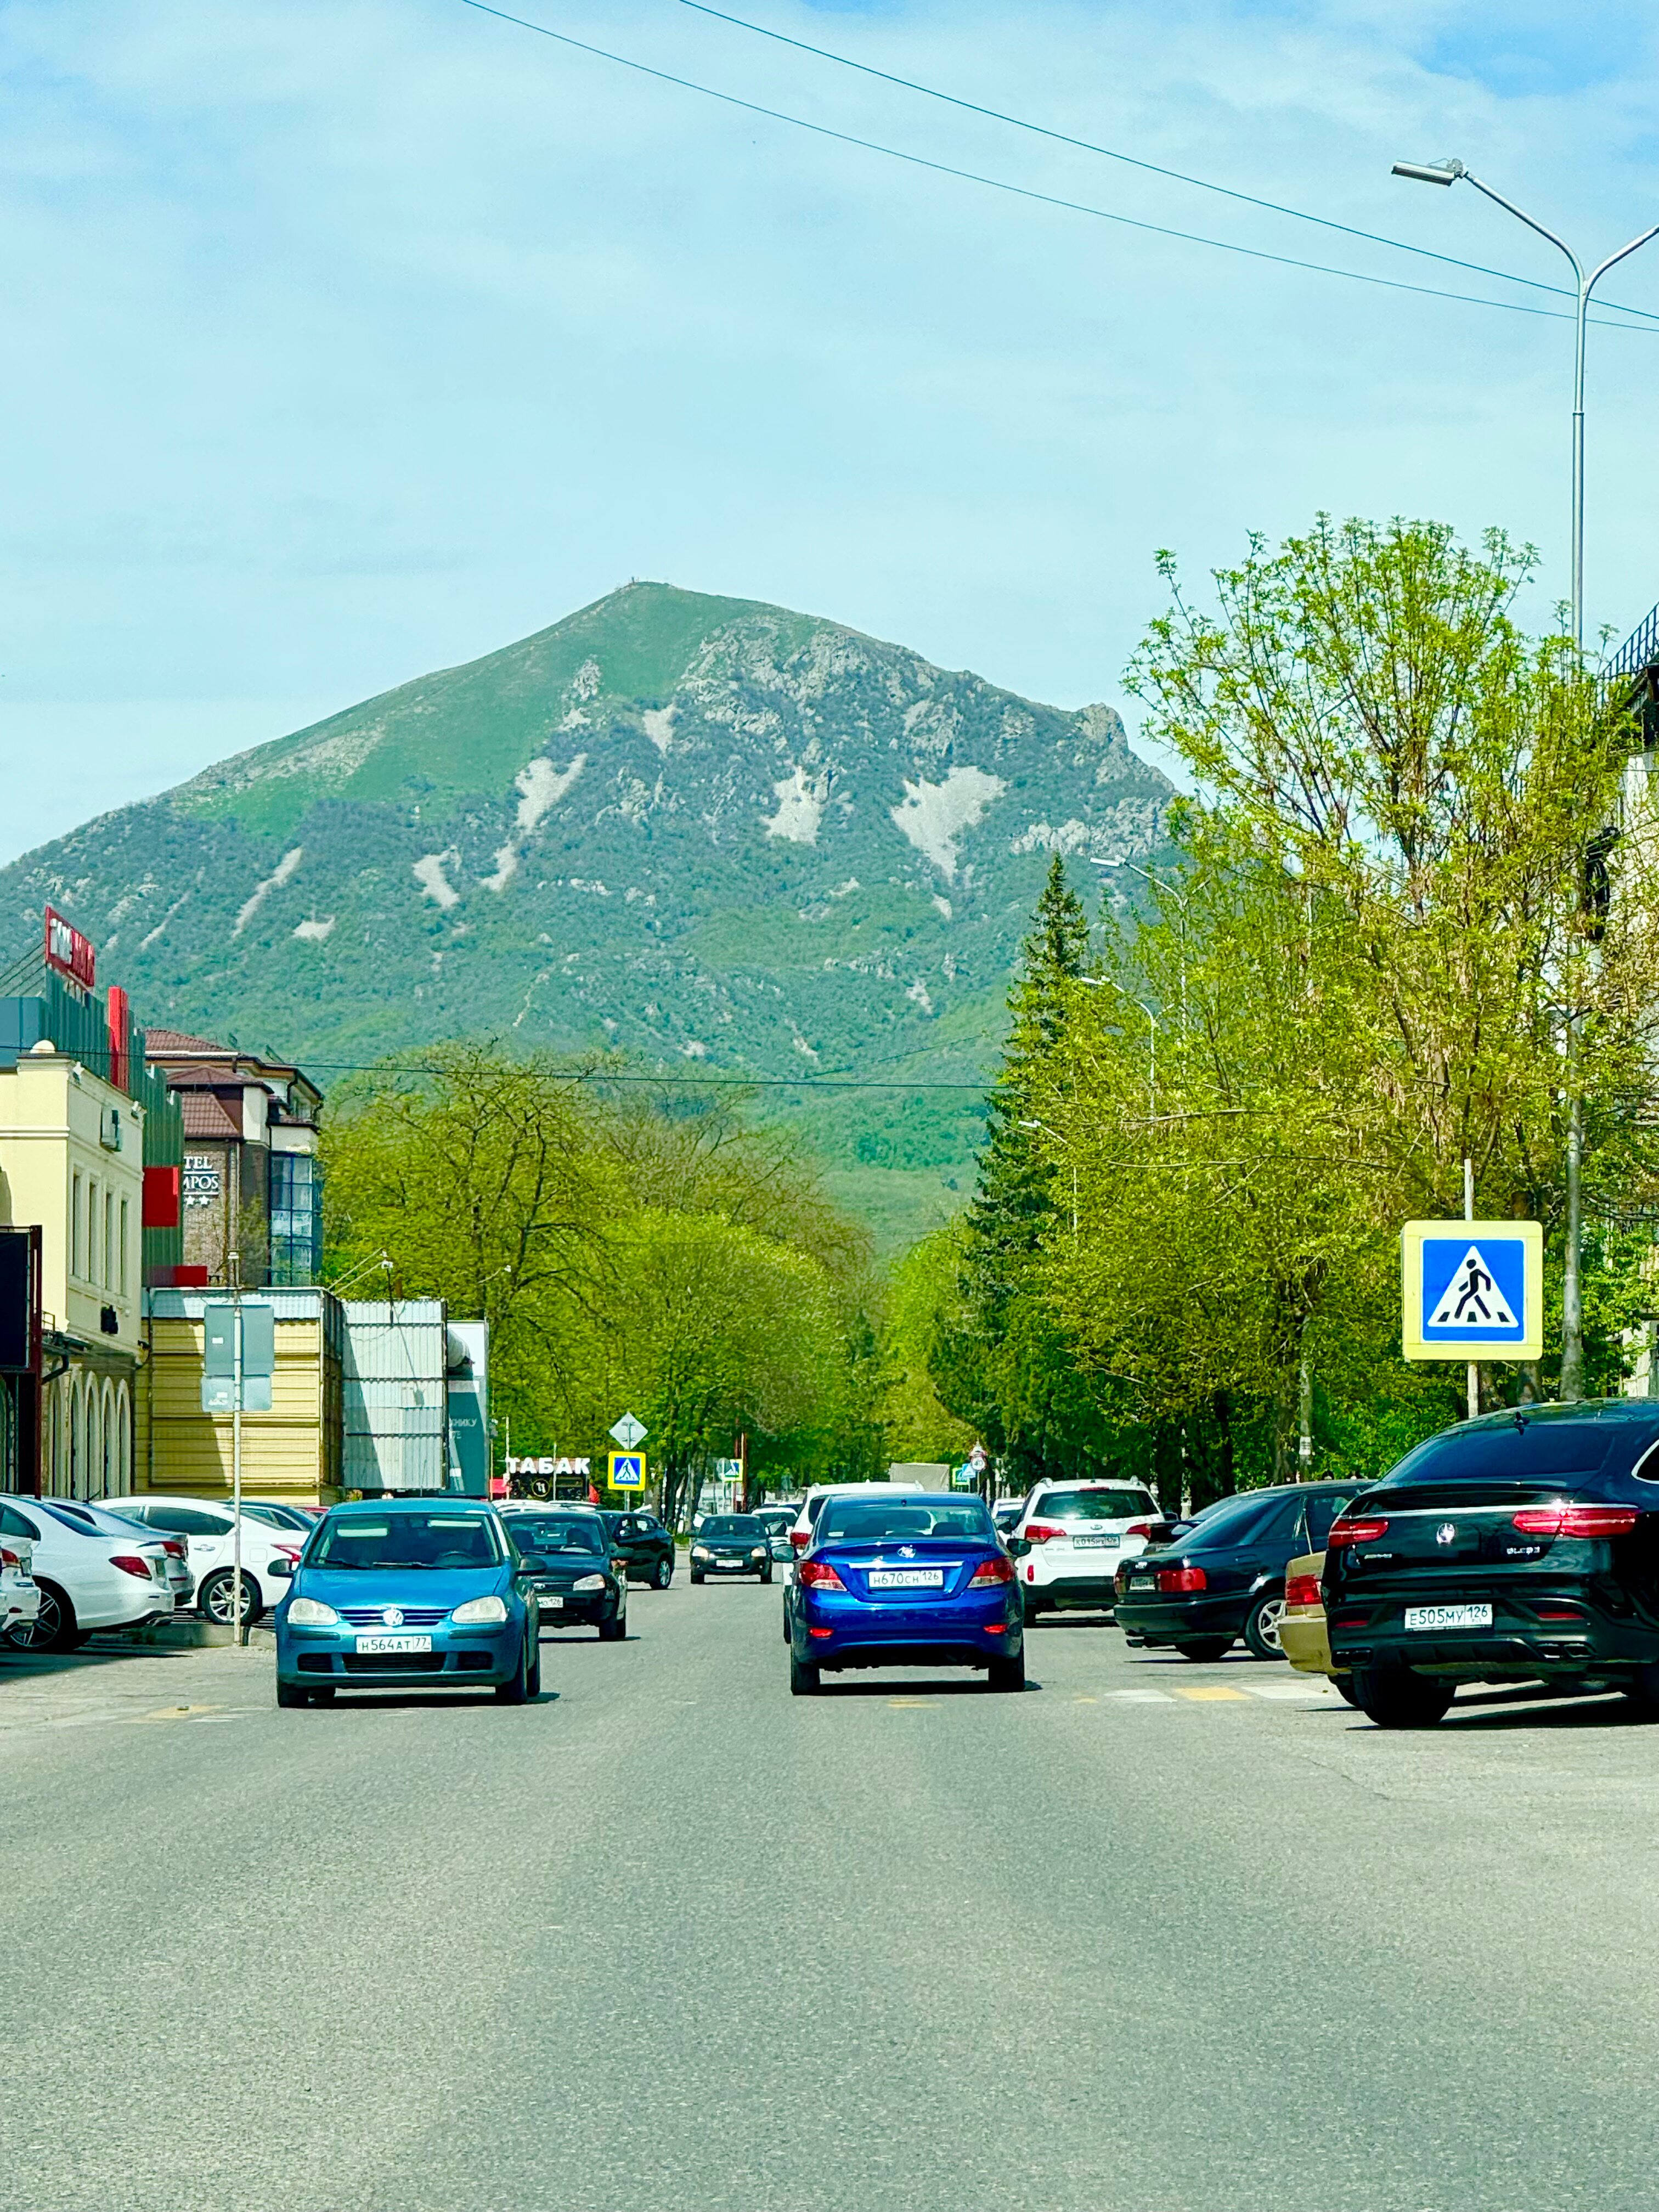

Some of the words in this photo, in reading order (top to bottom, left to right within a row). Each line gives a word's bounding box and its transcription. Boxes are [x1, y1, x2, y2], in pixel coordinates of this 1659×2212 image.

[183, 1156, 212, 1169] TEL
[505, 1457, 590, 1474] ТАБАК
[922, 1571, 939, 1581] 126
[1466, 1605, 1488, 1618] 126
[362, 1638, 411, 1651] Н564АТ
[415, 1637, 427, 1649] 77
